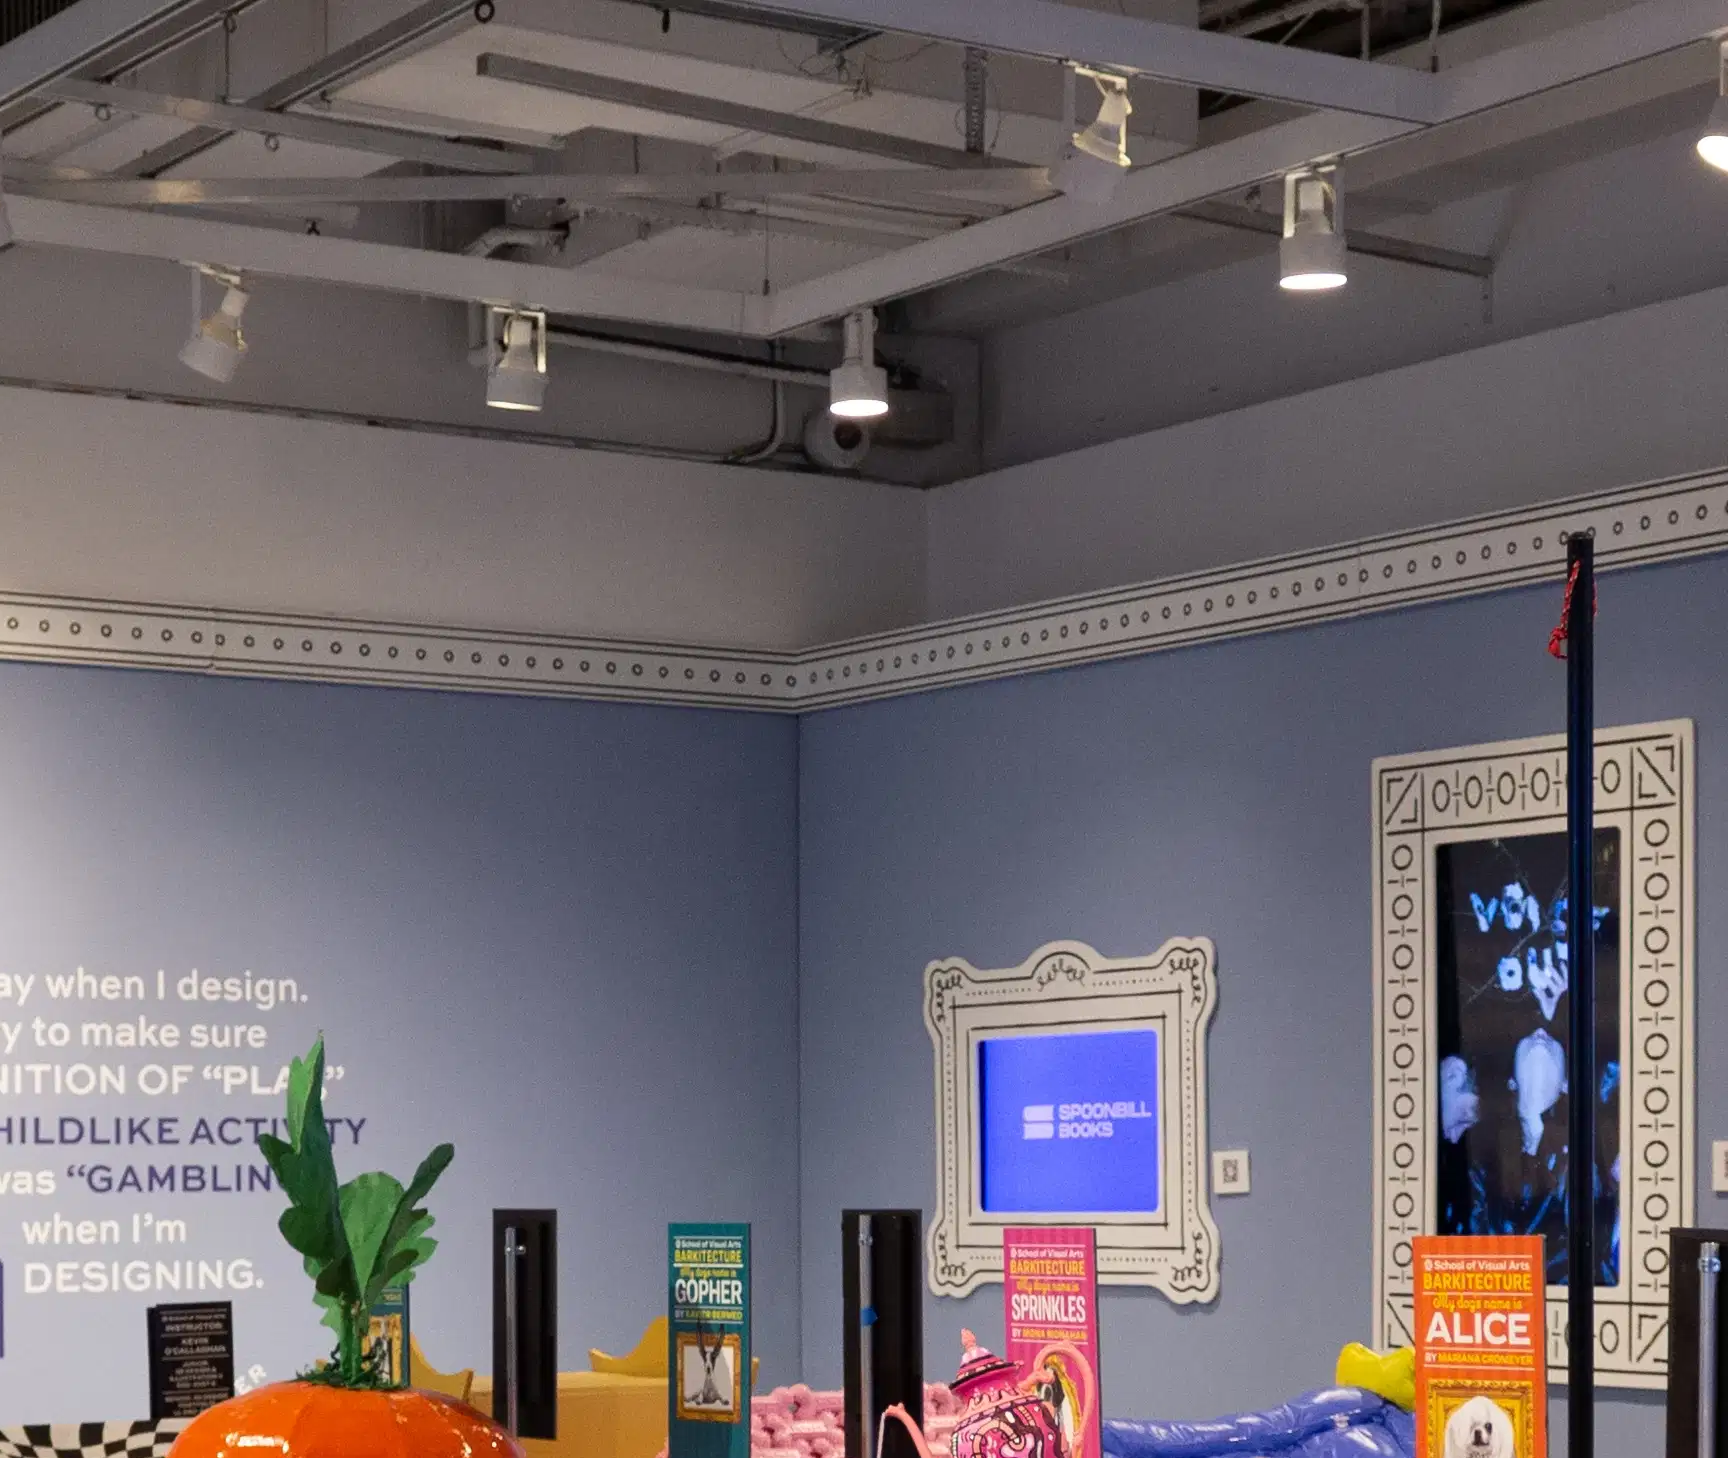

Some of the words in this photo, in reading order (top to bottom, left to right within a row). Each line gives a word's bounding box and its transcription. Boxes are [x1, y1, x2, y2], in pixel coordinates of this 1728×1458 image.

[46, 970, 146, 1000] when
[157, 971, 165, 1000] I
[177, 970, 309, 1010] design.
[33, 1020, 70, 1047] to
[81, 1016, 180, 1048] make
[190, 1025, 267, 1049] sure
[137, 1065, 193, 1096] OF
[202, 1064, 345, 1101] “PLA,”
[1058, 1100, 1152, 1120] SPOONBILL
[192, 1117, 367, 1145] ACTITY
[1058, 1120, 1114, 1138] BOOKS
[66, 1164, 272, 1193] “GAMBLIN
[22, 1213, 119, 1245] when
[132, 1214, 187, 1244] I’m
[674, 1249, 742, 1263] BARKITECTURE
[1010, 1259, 1085, 1276] BARKITECTURE
[1434, 1259, 1464, 1271] School
[1478, 1260, 1507, 1271] Visual
[1509, 1261, 1530, 1271] Arts
[23, 1260, 265, 1293] DESIGNING.
[1423, 1272, 1532, 1291] BARKITECTURE
[675, 1278, 743, 1305] GOPHER
[1011, 1293, 1086, 1323] SPRINKLES
[1425, 1311, 1532, 1346] ALICE
[1424, 1352, 1437, 1363] BY
